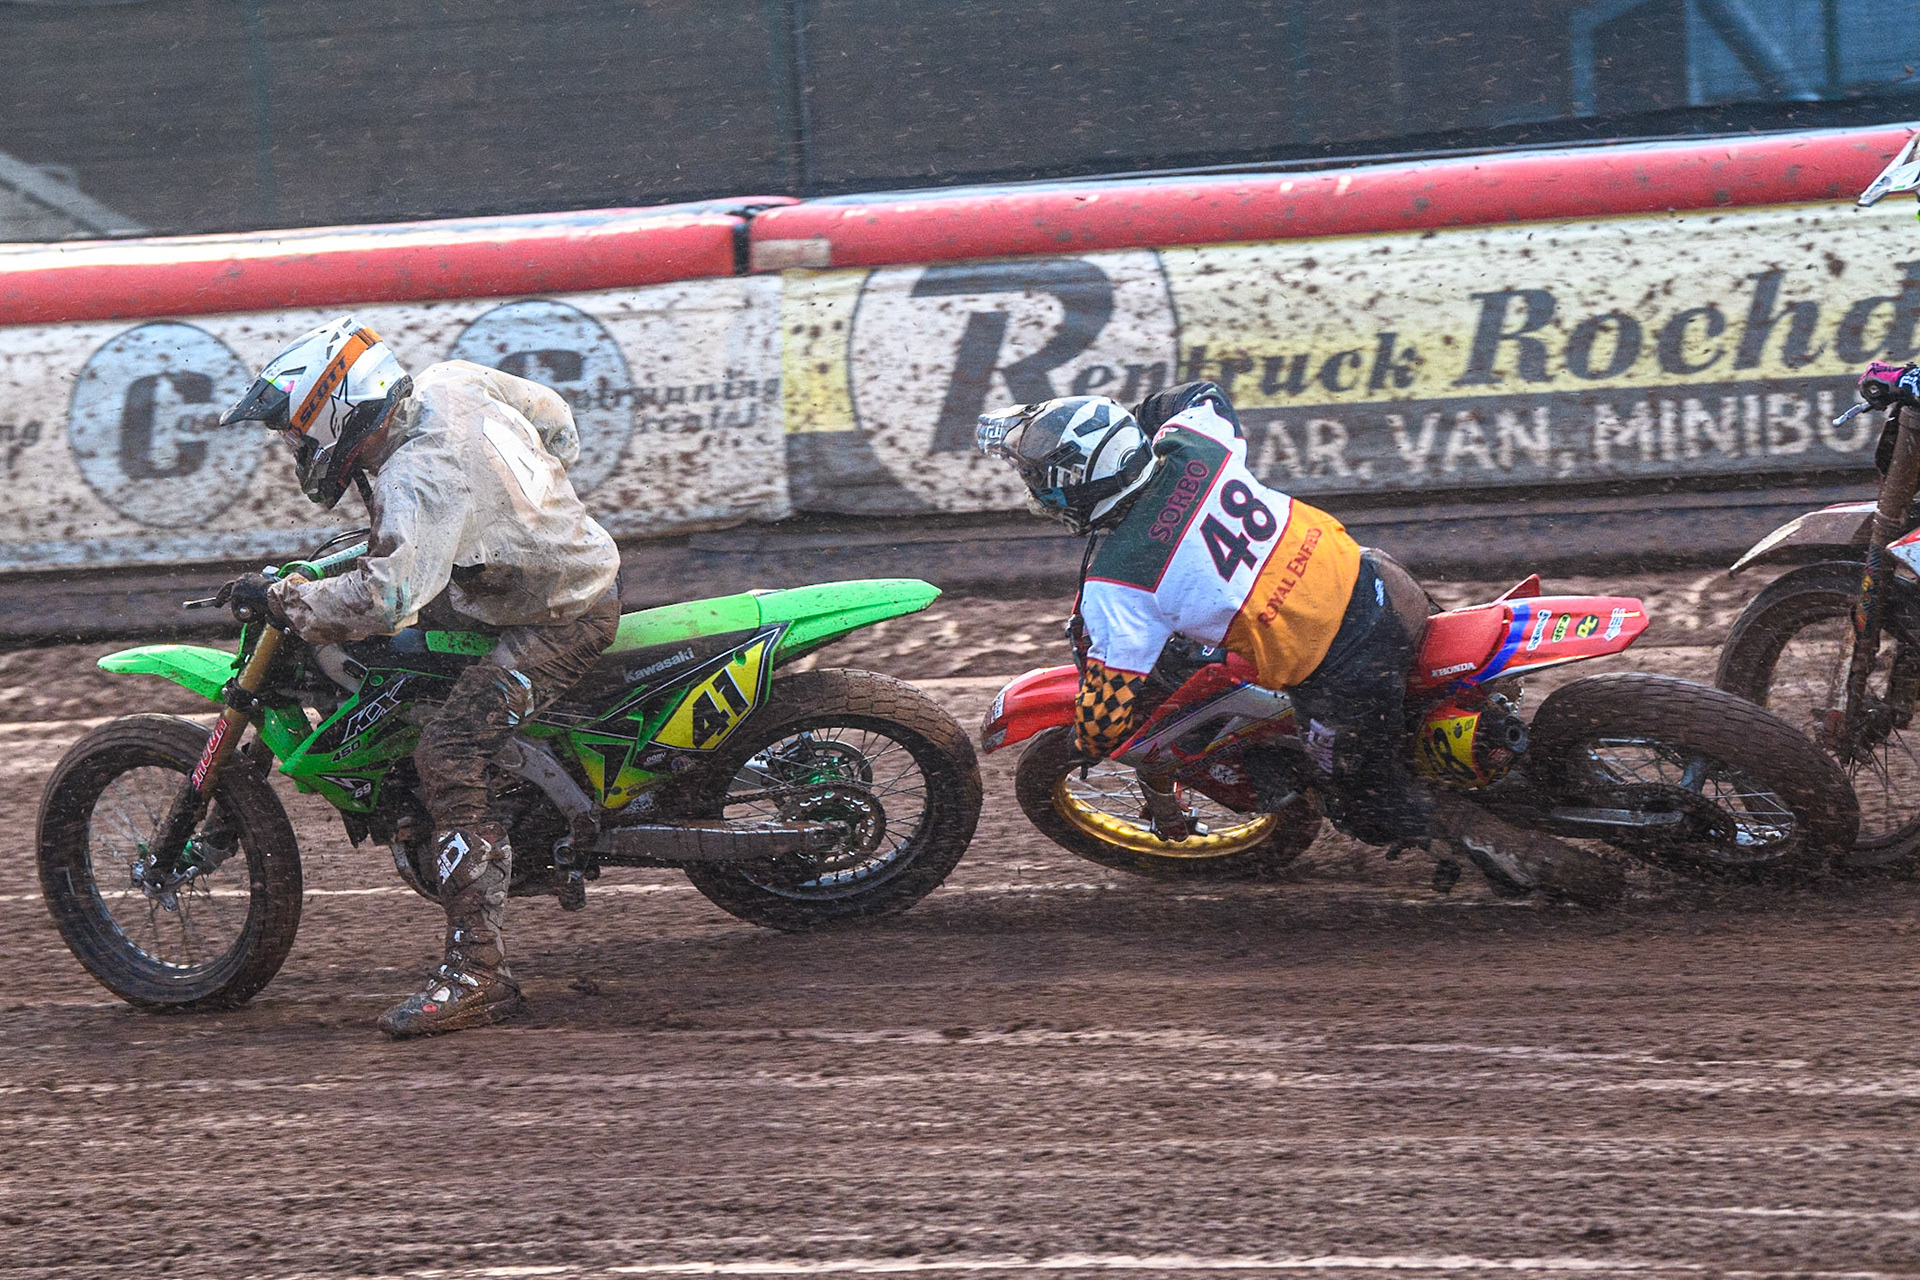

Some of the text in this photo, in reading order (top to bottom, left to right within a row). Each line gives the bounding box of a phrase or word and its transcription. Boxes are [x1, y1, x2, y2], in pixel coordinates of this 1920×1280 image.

[299, 354, 346, 427] SCOTT
[1240, 390, 1893, 480] AR, VAN, MINIBU
[1149, 459, 1210, 544] SORBO
[1199, 478, 1278, 583] 48
[1256, 573, 1297, 629] ROYAL
[623, 647, 696, 683] Kawasaki
[1439, 661, 1478, 677] HONDA
[691, 666, 752, 749] 41
[354, 782, 372, 799] 69
